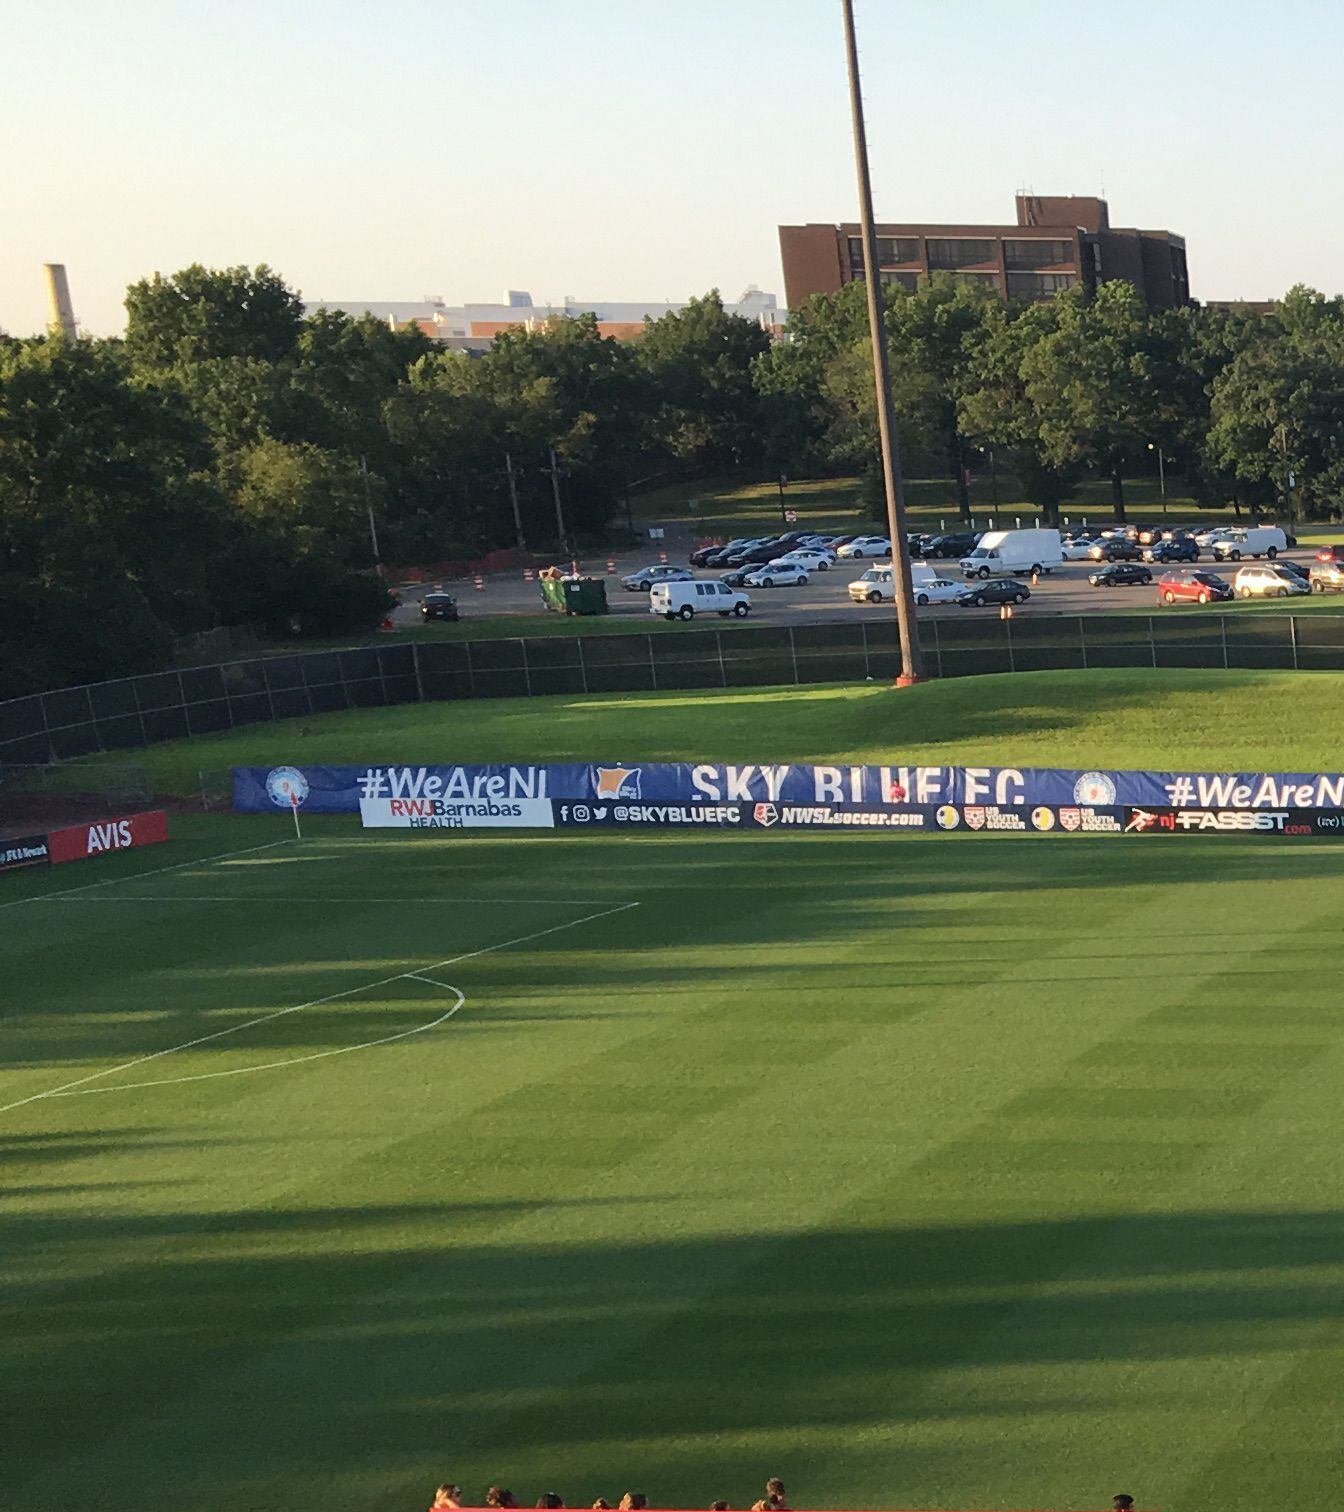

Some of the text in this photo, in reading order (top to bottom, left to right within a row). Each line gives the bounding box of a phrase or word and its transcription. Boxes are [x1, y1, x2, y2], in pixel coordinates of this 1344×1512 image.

[691, 765, 790, 802] SKY
[964, 768, 1025, 805] FC
[390, 799, 522, 817] RWJBarnabas
[613, 806, 741, 823] @SKYBLUEFC
[410, 817, 463, 828] HEALTH
[781, 807, 924, 826] NWSLsoccer.com
[985, 814, 1018, 822] YOUTH
[1081, 815, 1115, 824] YOUTH
[1317, 816, 1340, 829] (we)
[985, 821, 1025, 830] SOCCER
[1081, 822, 1121, 831] SOCCER
[87, 820, 132, 854] AVIS
